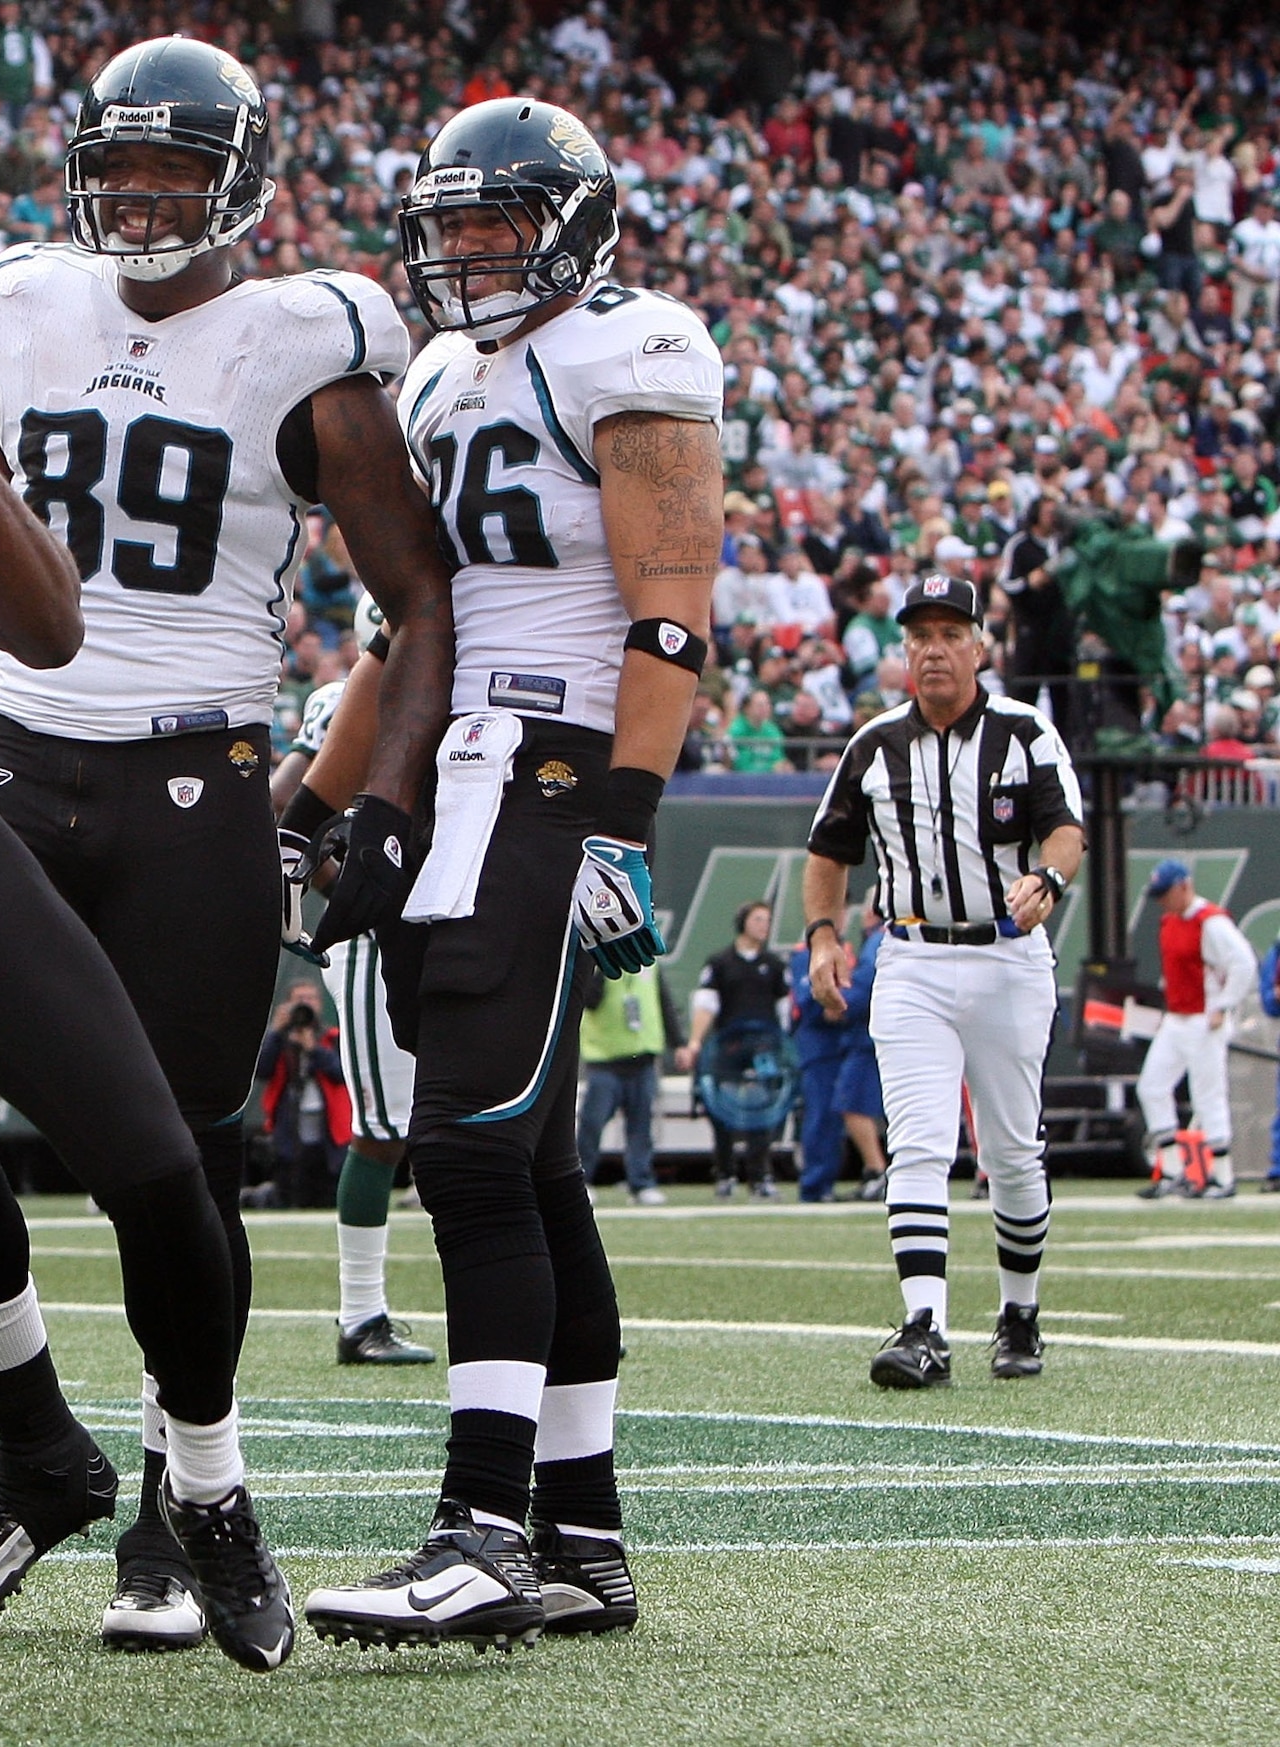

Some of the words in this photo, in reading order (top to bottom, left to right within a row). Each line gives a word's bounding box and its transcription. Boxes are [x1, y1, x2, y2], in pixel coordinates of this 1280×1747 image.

[119, 110, 154, 123] Riddell
[434, 170, 465, 185] Riddell
[80, 374, 168, 407] JAGUARS
[17, 407, 234, 596] 89
[449, 750, 486, 761] Wilson
